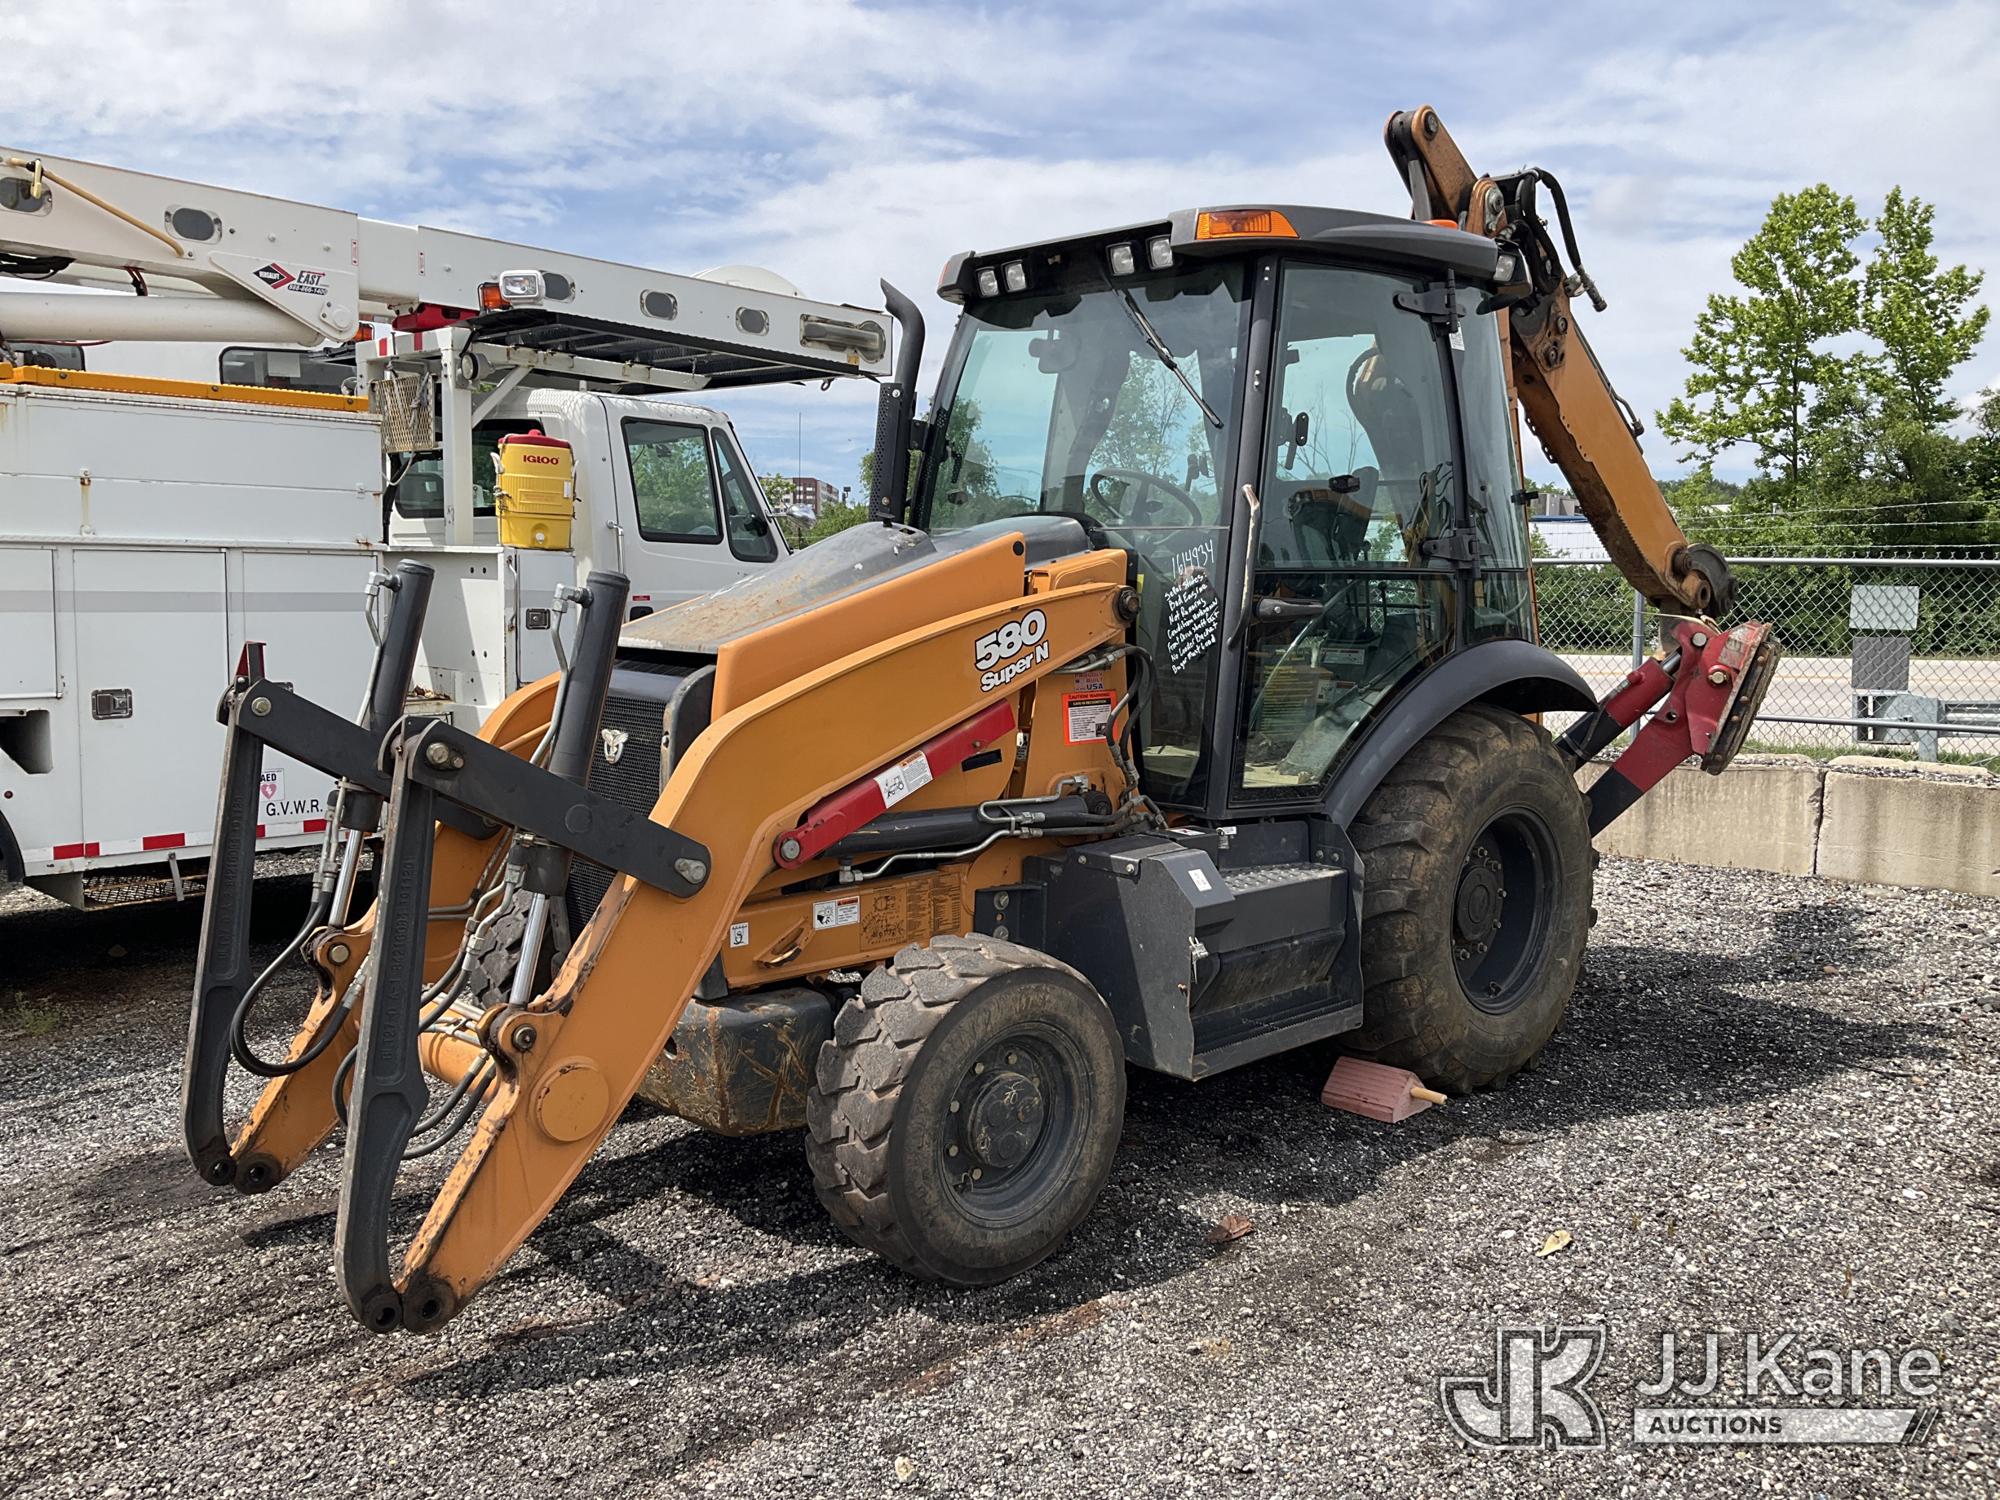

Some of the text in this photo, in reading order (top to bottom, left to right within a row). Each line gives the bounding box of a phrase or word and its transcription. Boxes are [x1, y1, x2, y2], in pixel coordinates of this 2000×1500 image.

[297, 270, 323, 286] EAST
[523, 455, 560, 465] IGLOO
[1172, 539, 1214, 579] 1614934
[975, 609, 1047, 671] 580
[980, 640, 1049, 692] Super N
[261, 773, 277, 782] AED
[266, 799, 323, 816] G.V.W.R.
